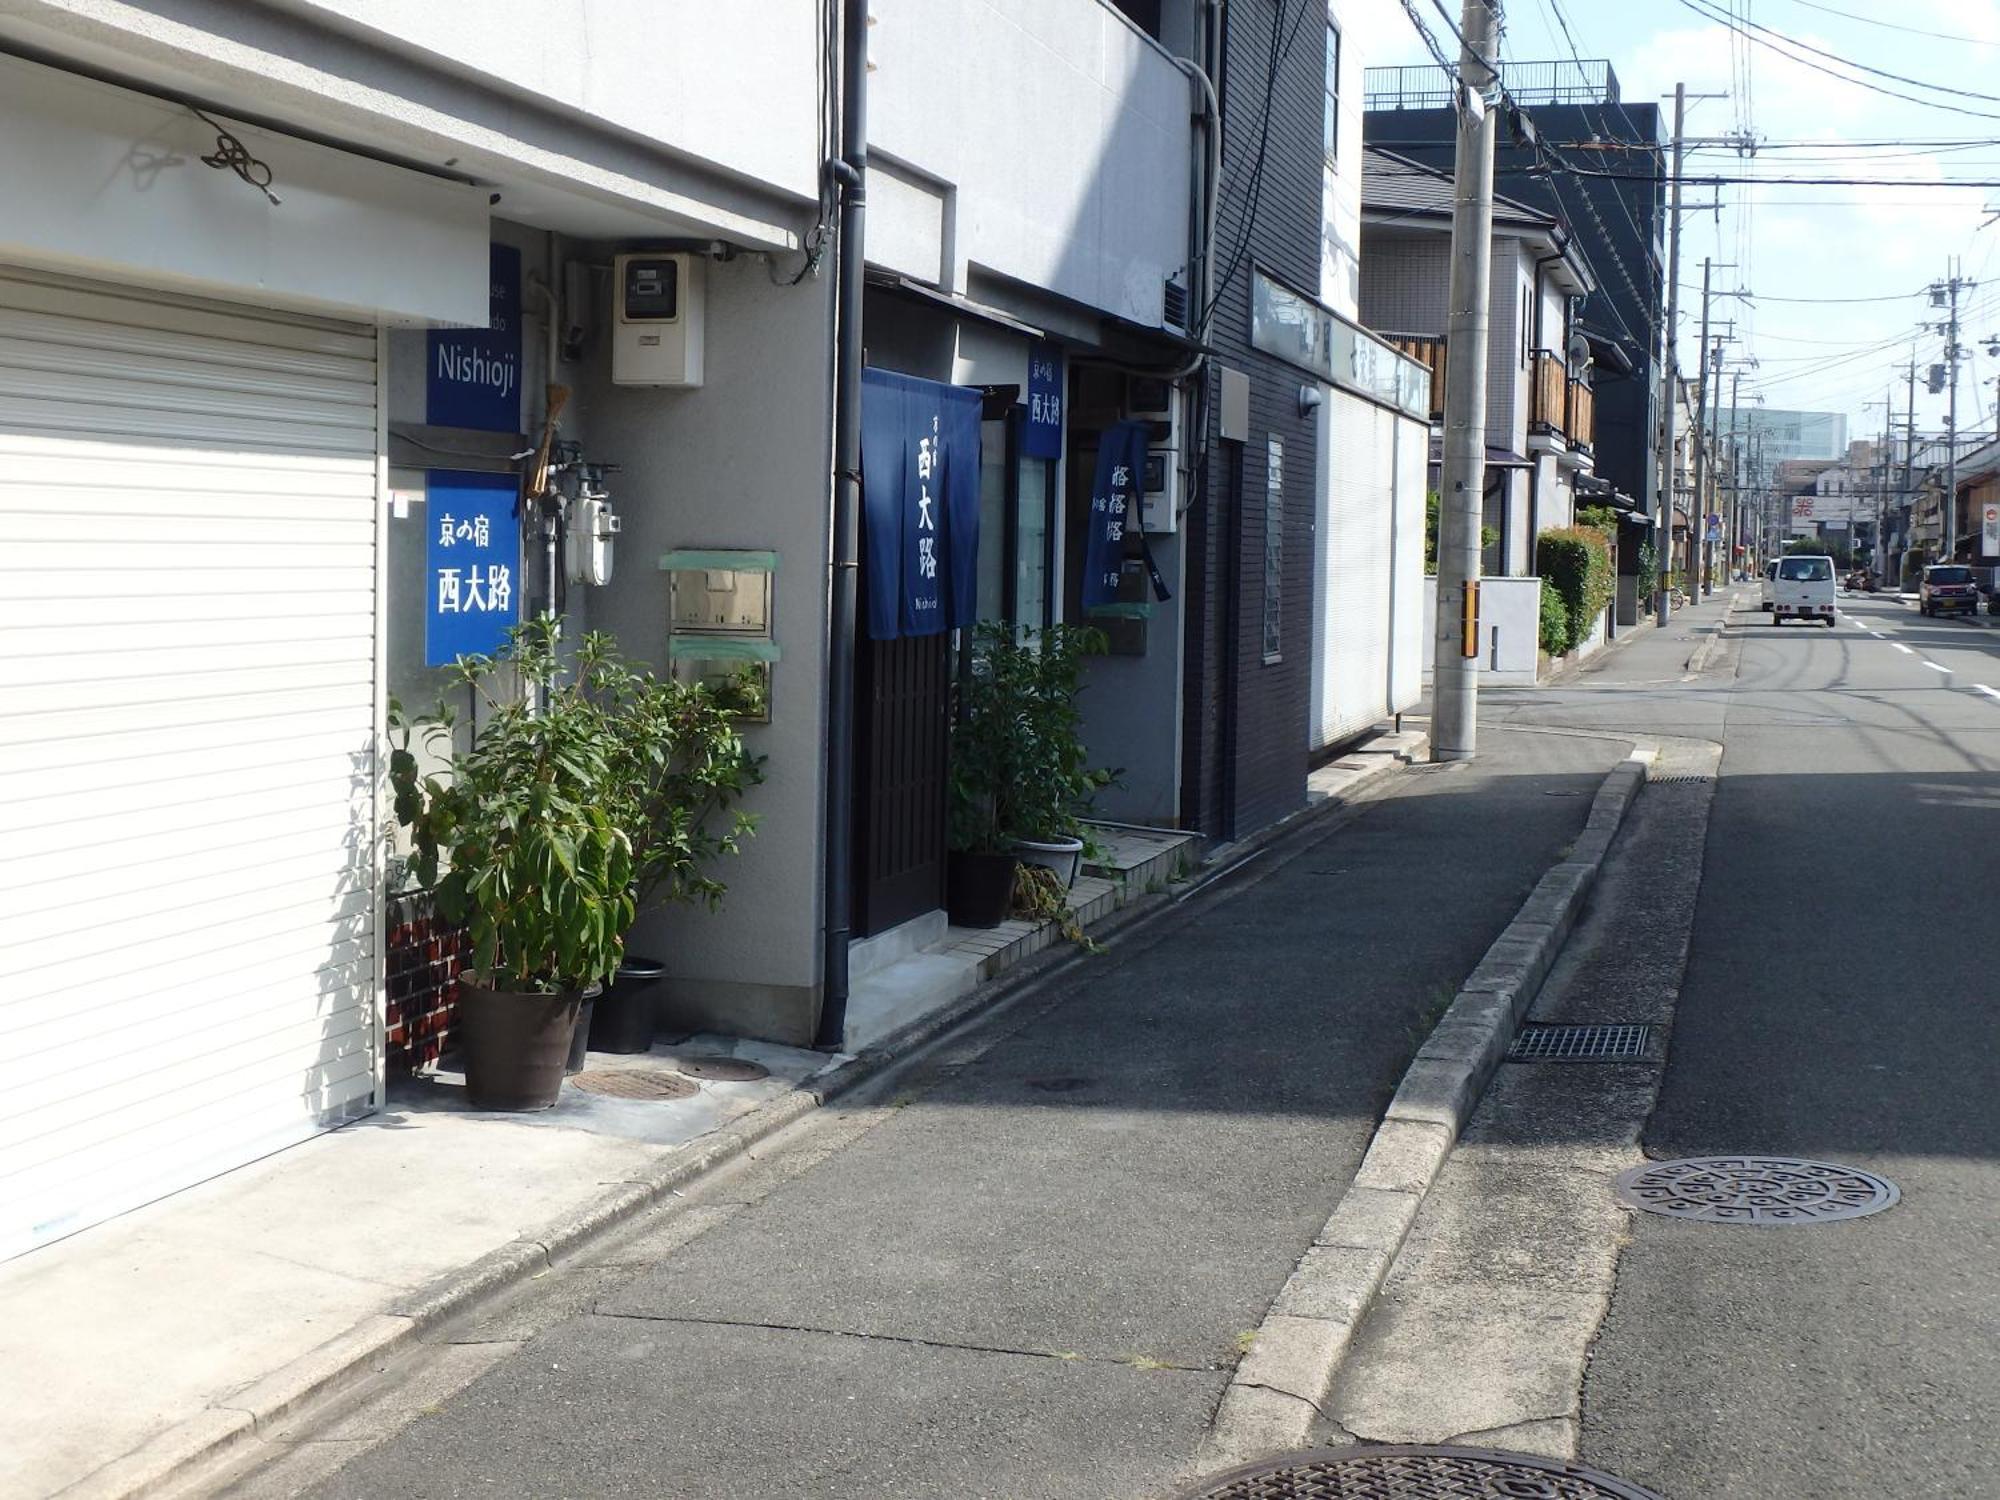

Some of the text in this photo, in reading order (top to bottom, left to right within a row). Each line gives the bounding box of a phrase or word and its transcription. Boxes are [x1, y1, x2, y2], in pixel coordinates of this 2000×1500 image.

[438, 342, 513, 397] Nishioji
[1032, 393, 1059, 425] 西大路
[439, 513, 489, 547] 京の宿
[918, 438, 937, 579] 西大路
[438, 565, 511, 613] 西大路
